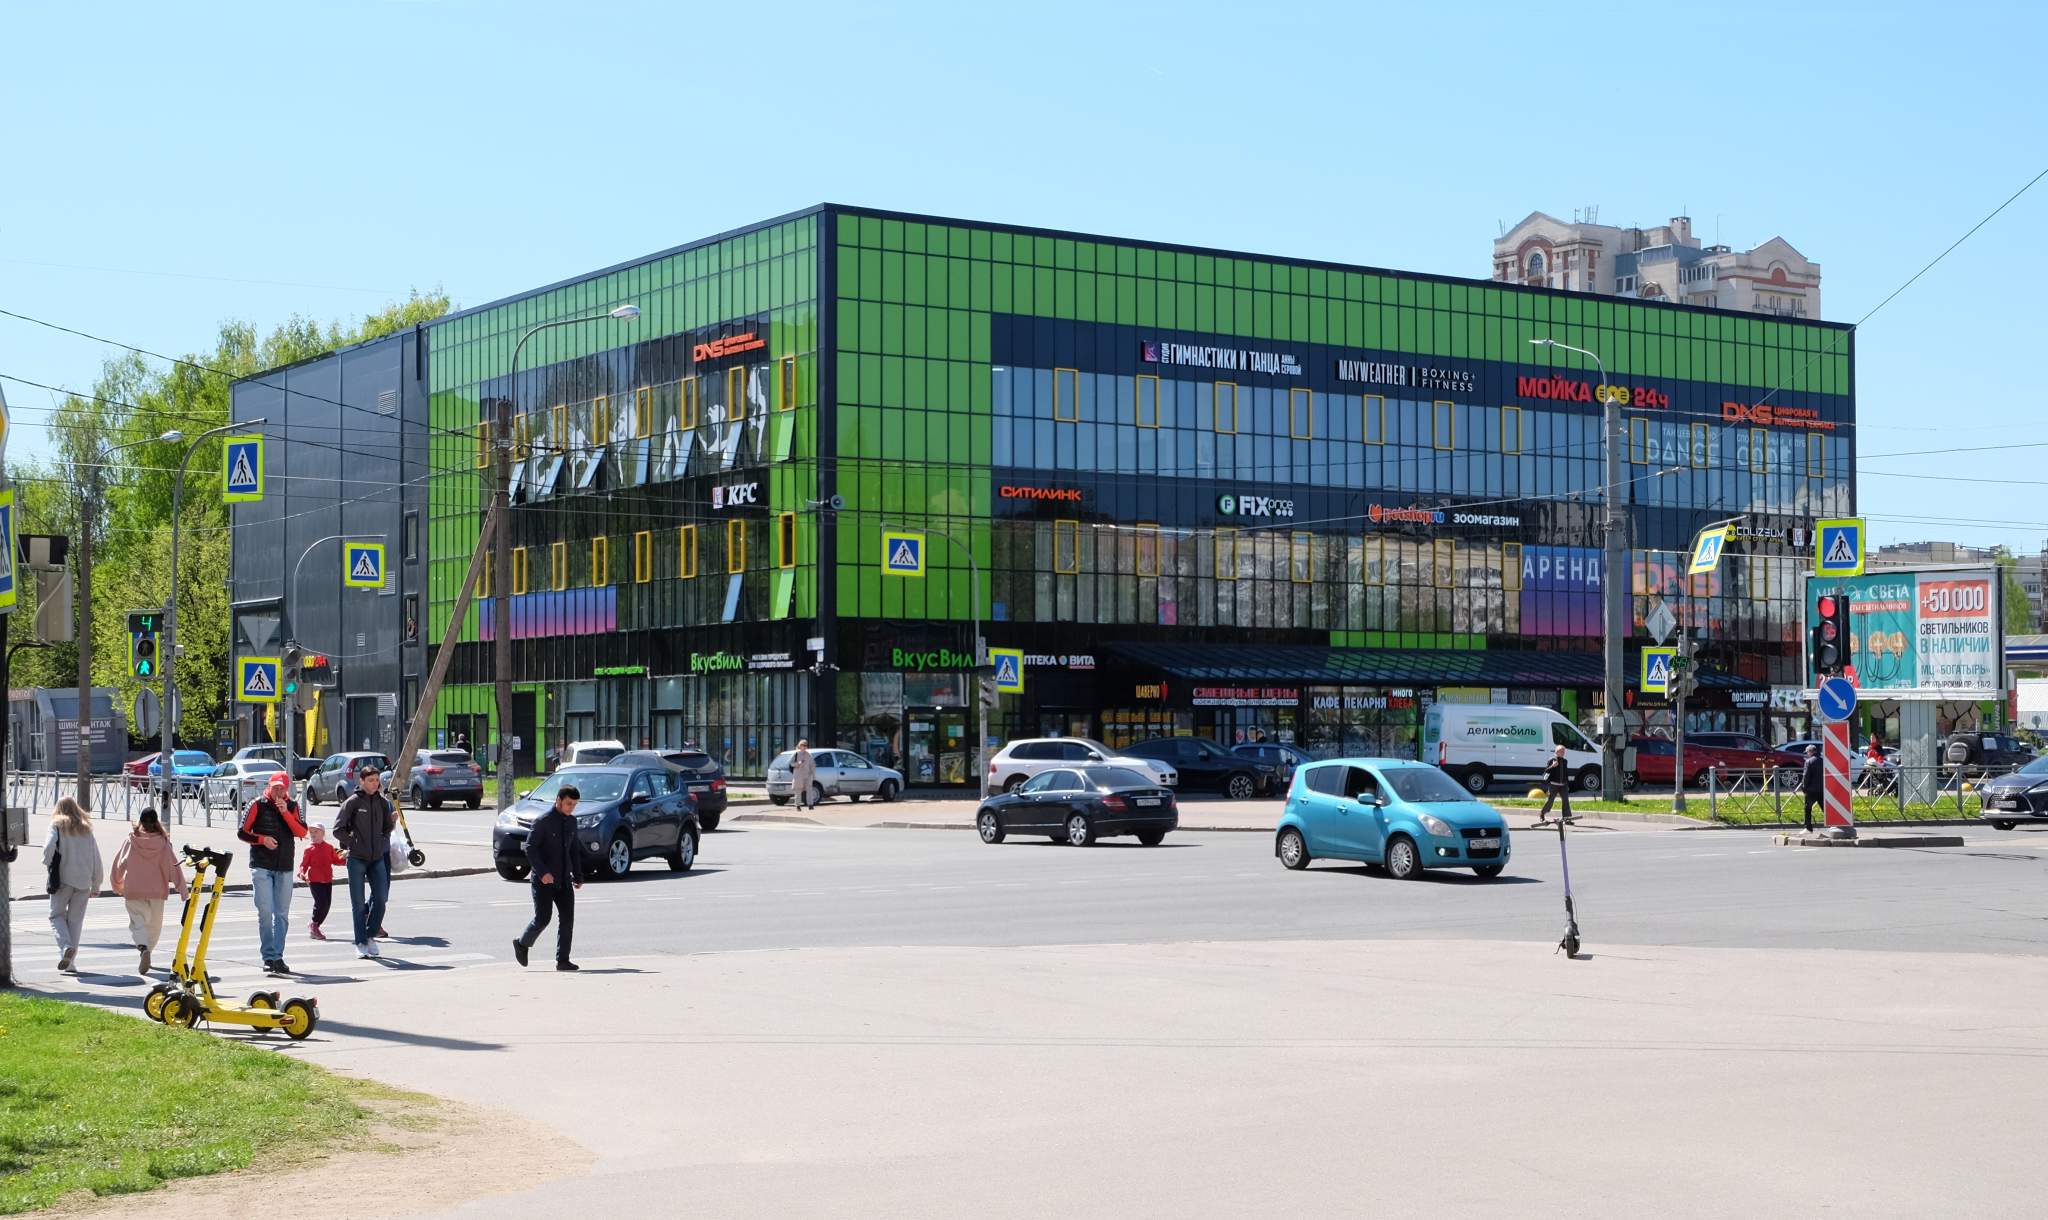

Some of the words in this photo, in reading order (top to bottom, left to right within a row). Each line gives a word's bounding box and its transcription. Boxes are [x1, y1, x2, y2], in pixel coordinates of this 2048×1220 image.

[693, 339, 724, 362] DNS
[1161, 343, 1169, 364] СТУДИЯ
[1171, 344, 1237, 370] ГИМНАСТИКИ
[1239, 351, 1247, 370] И
[1249, 351, 1280, 375] ТАНЦА
[1281, 354, 1295, 365] АННЫ
[1281, 364, 1302, 376] СЕРОВОЙ
[1339, 359, 1406, 386] MAYWEATHER
[1422, 378, 1473, 392] FITNESS
[1518, 375, 1591, 403] МОЙКА
[1633, 387, 1669, 409] 24ч
[1723, 402, 1772, 425] DNS
[1775, 407, 1811, 417] ЦИФРОВАЯ
[1775, 417, 1805, 427] БЫТОВАЯ
[1806, 420, 1836, 430] ТЕХНИКА
[727, 482, 758, 505] KFC
[1001, 486, 1081, 501] СИТИЛИНК
[1453, 513, 1519, 526] зоомагазин
[1736, 526, 1784, 538] COLIZEUM
[1523, 556, 1600, 585] АРЕНД
[1870, 584, 1909, 599] СВЕТА
[141, 616, 152, 630] 4
[1920, 622, 1989, 635] СВЕТИЛЬНИКОВ
[1921, 638, 1929, 653] В
[1931, 637, 1990, 653] НАЛИЧИИ
[892, 648, 975, 671] ВкусВил
[1024, 655, 1057, 665] ПТЕКА
[1070, 656, 1095, 666] ВИТА
[1921, 665, 1934, 678] МЦ
[1193, 688, 1260, 698] СМЕШНЫЕ
[1261, 688, 1297, 698] ЦЕНЫ
[1392, 689, 1412, 697] МНОГО
[1732, 692, 1767, 702] ПОСТИРУШКИ
[1770, 689, 1807, 708] KFC
[1314, 697, 1339, 709] КАФЕ
[1344, 697, 1386, 709] ПЕКАРНЯ
[1388, 698, 1412, 709] ХЛЕБА
[58, 720, 112, 730] ШИНОНТАЖ
[1467, 726, 1536, 736] делимобиль
